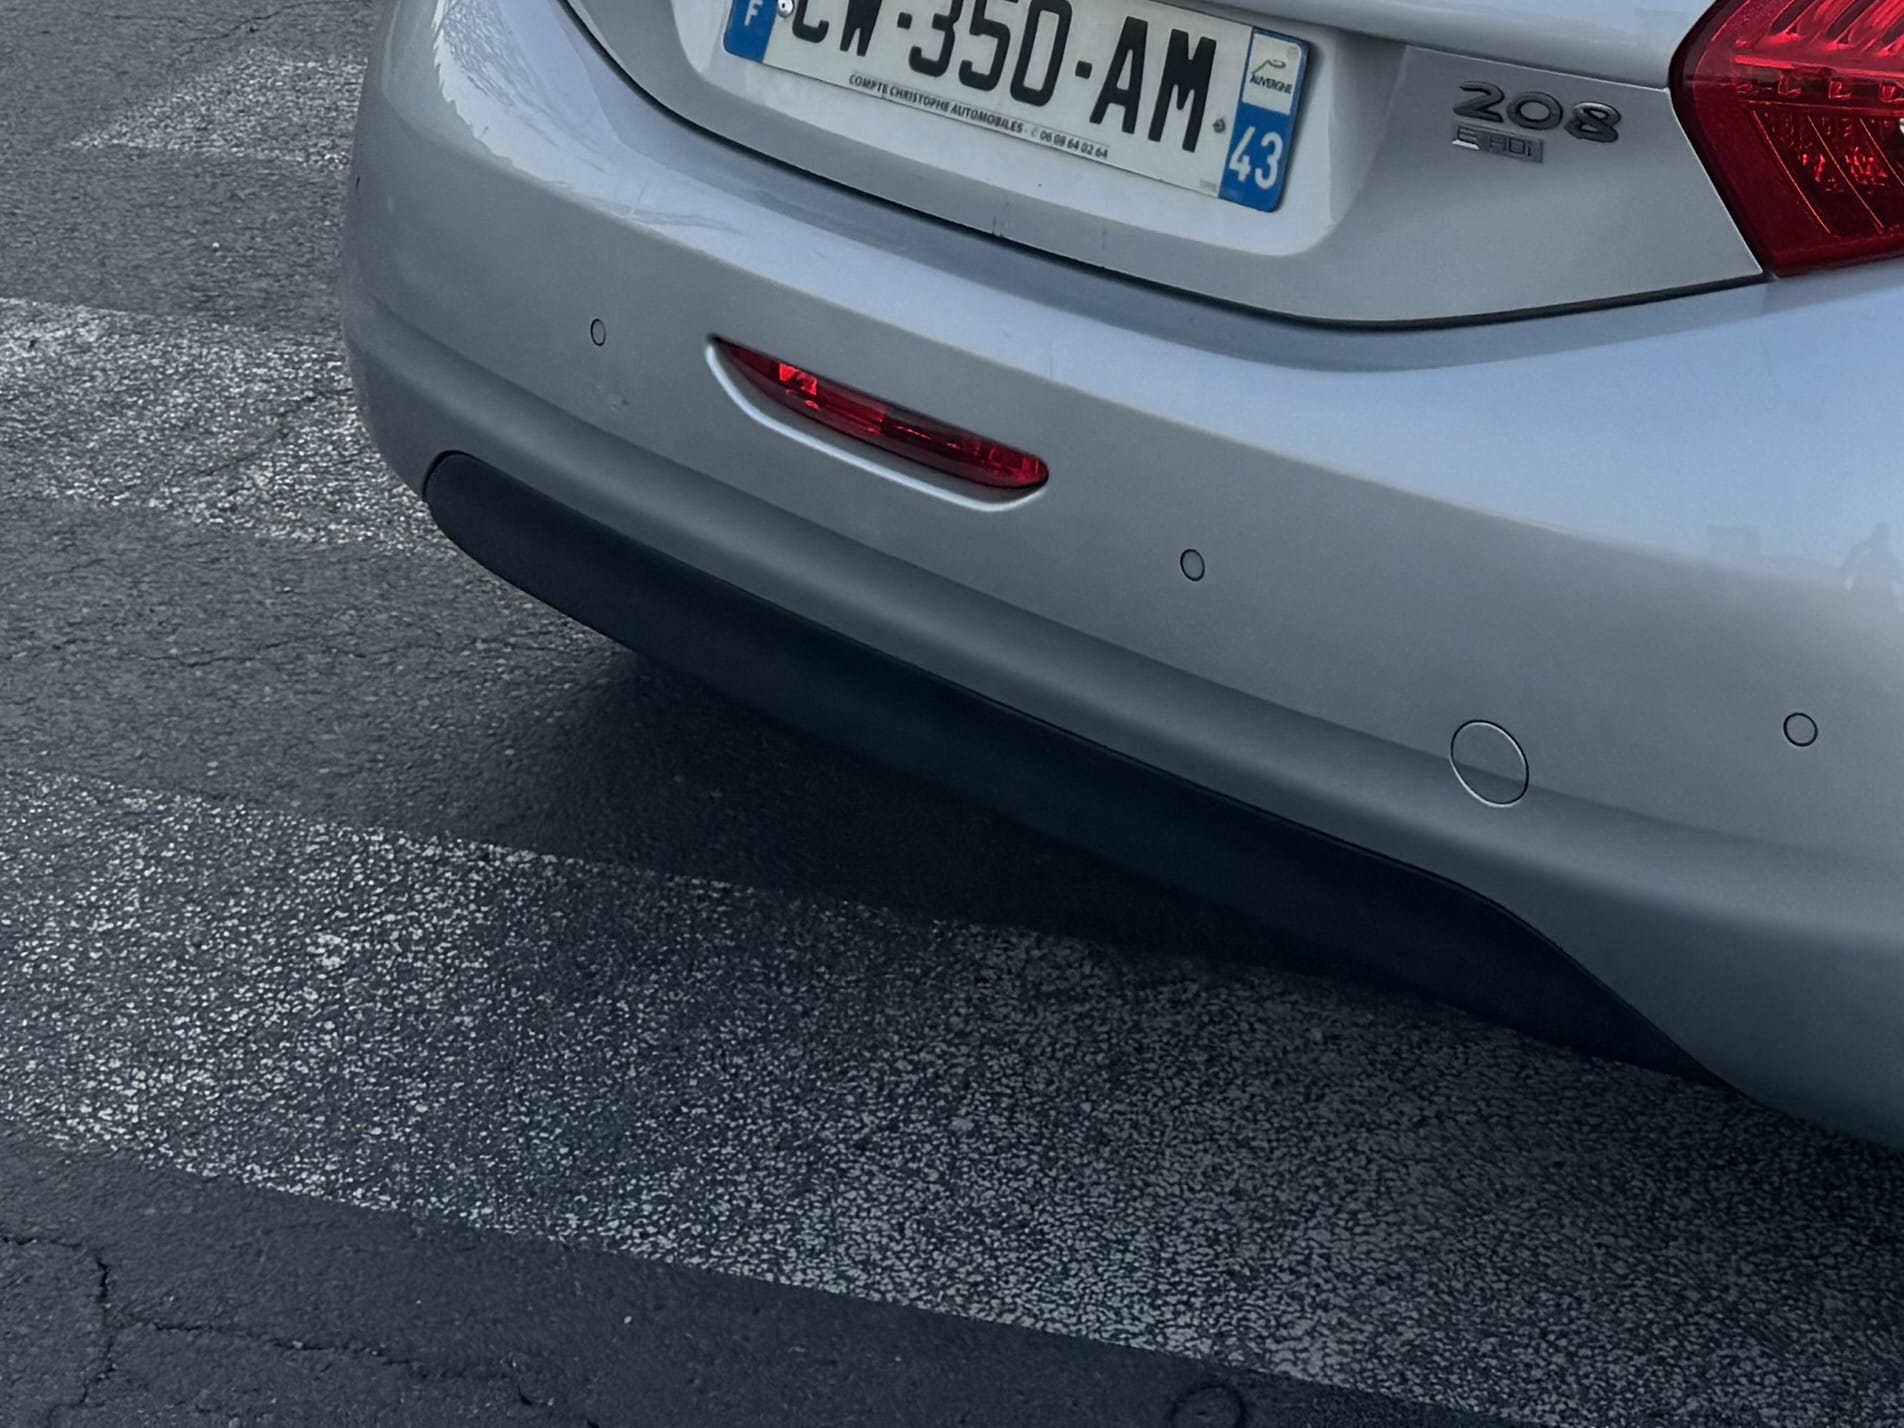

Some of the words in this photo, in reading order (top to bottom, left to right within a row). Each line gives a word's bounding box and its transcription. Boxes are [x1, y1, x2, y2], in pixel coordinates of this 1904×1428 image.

[848, 73, 889, 94] COMPTE
[890, 86, 949, 112] CHRISTOPHE
[950, 104, 1023, 134] AUTOMOBILES
[1039, 129, 1053, 142] 06
[1249, 74, 1294, 95] AUVERGNE
[1453, 80, 1622, 143] 208
[1229, 126, 1283, 190] 43
